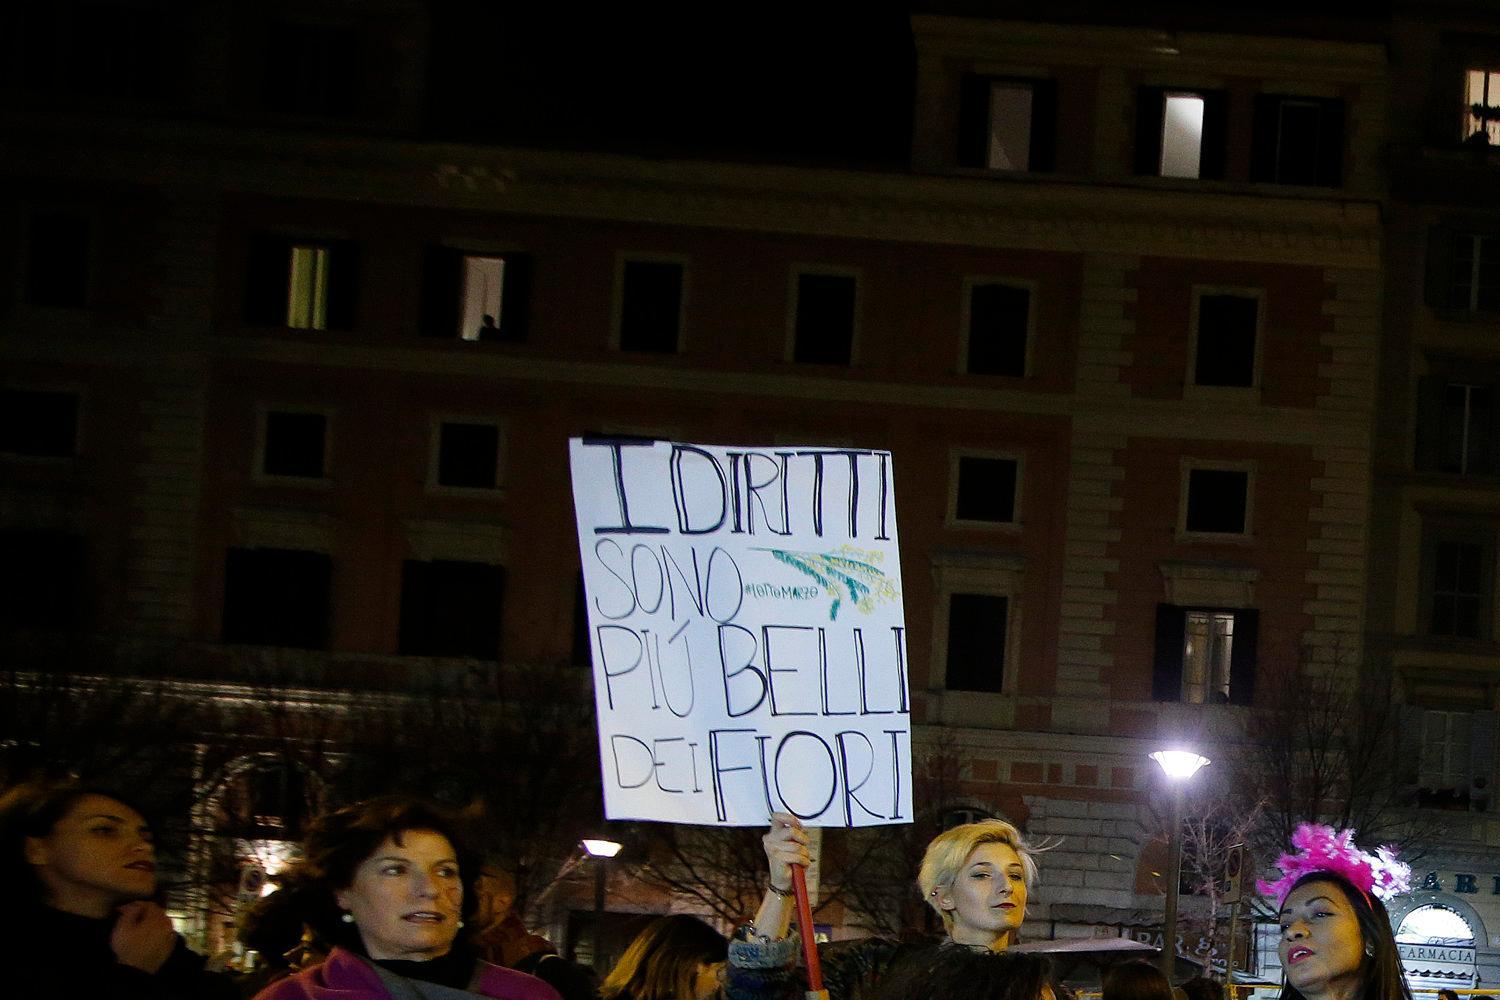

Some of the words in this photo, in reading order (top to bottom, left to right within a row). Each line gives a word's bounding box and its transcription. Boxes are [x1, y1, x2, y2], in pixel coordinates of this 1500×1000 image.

[582, 438, 671, 535] I
[670, 444, 891, 541] DIRITTI
[594, 538, 744, 624] SONO
[717, 623, 911, 718] BELLI
[611, 733, 703, 794] DEI
[708, 728, 907, 828] FIORI
[1399, 946, 1473, 962] FARMACIA
